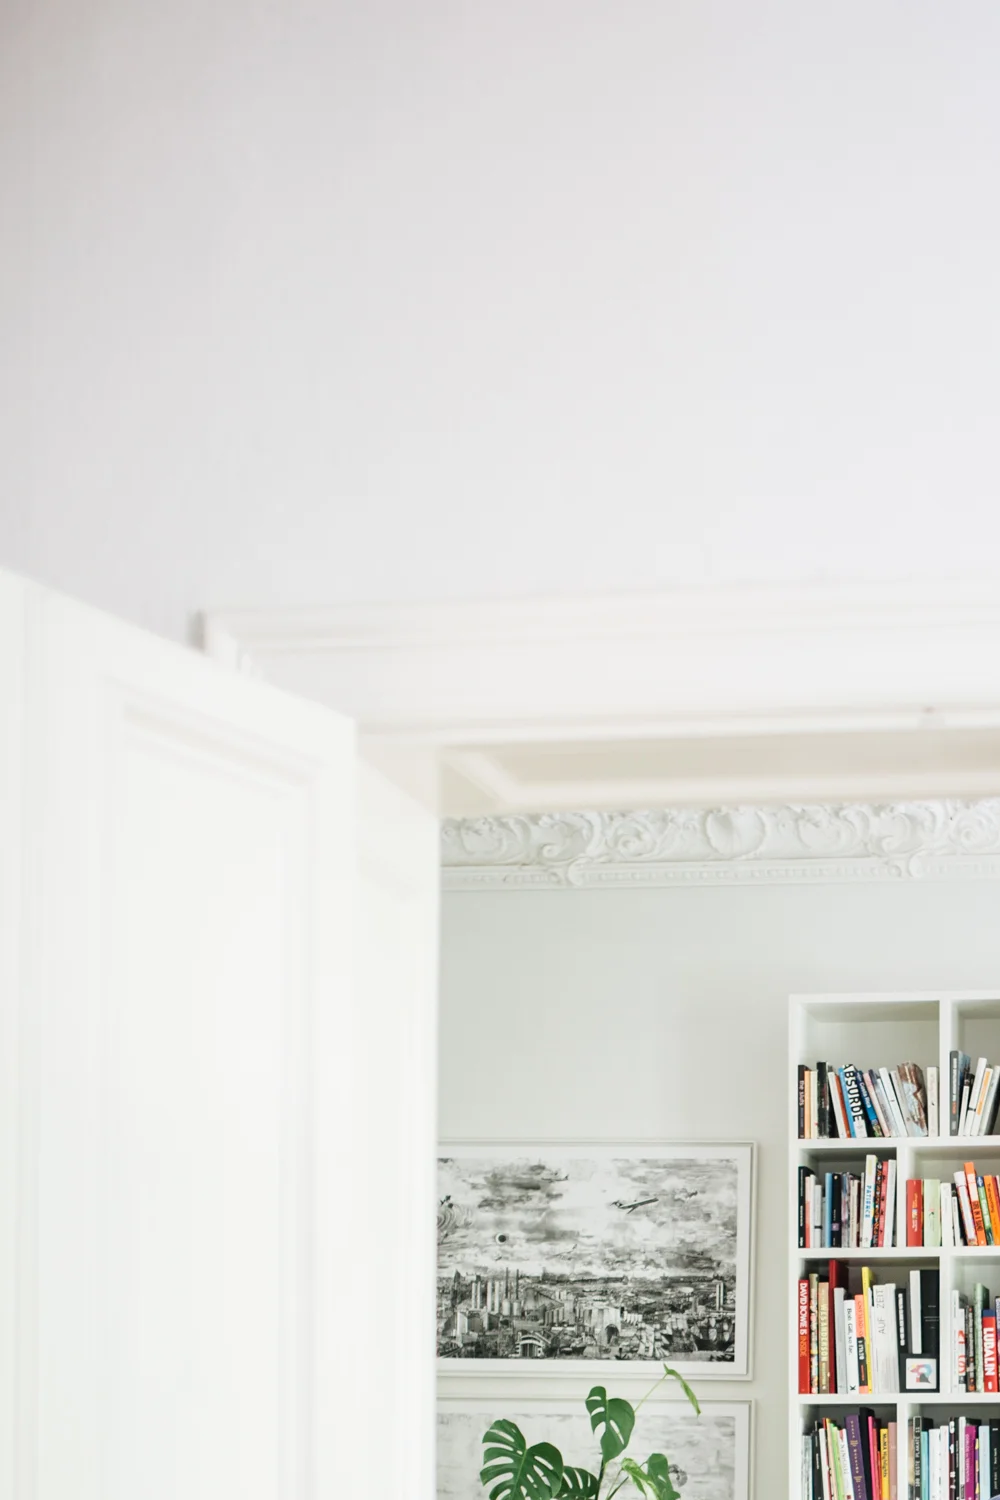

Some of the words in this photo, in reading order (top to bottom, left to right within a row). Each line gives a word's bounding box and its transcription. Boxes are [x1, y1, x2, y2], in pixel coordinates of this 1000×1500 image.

[843, 1064, 864, 1122] ABSURDE
[800, 1283, 809, 1304] DAVID
[876, 1289, 885, 1308] ZEIT
[800, 1305, 809, 1328] BOWIE
[877, 1318, 886, 1335] AUF
[820, 1322, 829, 1362] ANDERSON
